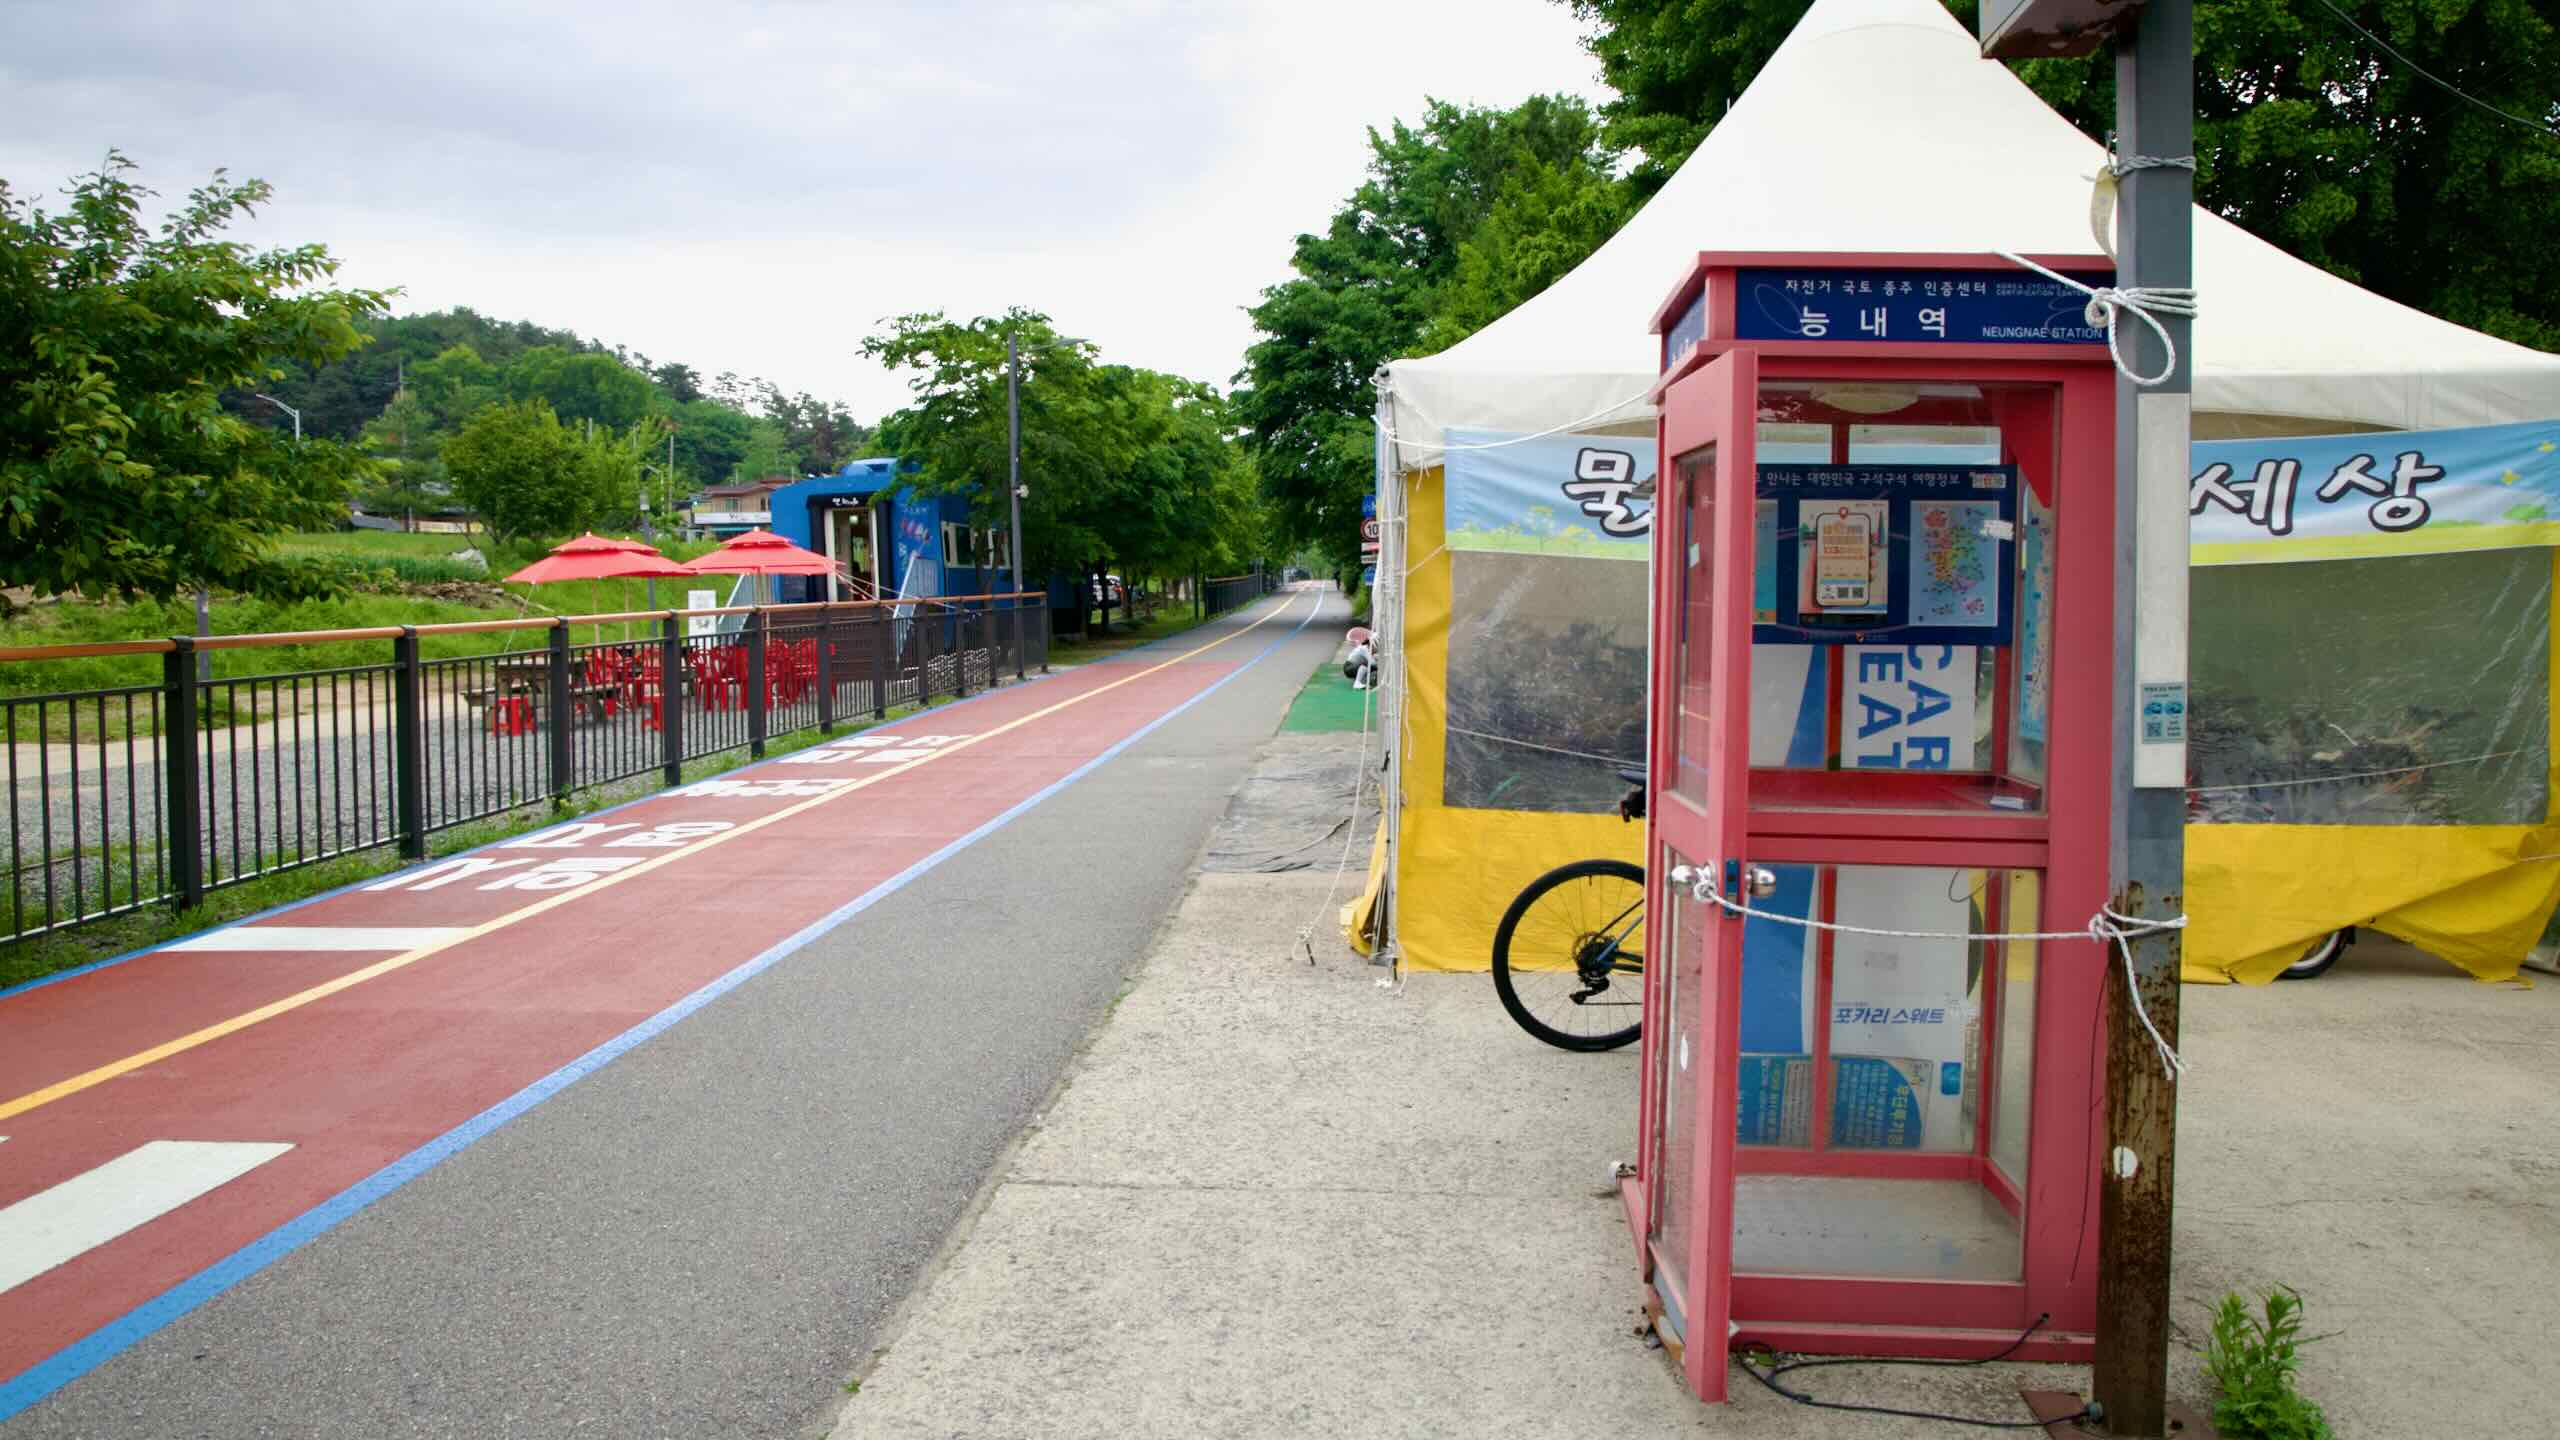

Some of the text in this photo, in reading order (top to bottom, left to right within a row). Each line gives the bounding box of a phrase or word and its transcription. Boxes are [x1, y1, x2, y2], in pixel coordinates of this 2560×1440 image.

[1785, 279, 1988, 297] 자전거 국토 종주 인증센터
[1799, 305, 1946, 338] 능내역
[1982, 326, 2103, 339] NEUNGNAE STATION
[1807, 472, 1855, 486] 대한민국
[1859, 472, 1907, 487] 구석구석
[1912, 472, 1960, 487] 여행정보
[498, 820, 737, 849] 정지
[360, 856, 648, 892] 일시
[1832, 1007, 1945, 1025] 포카리 스웨트
